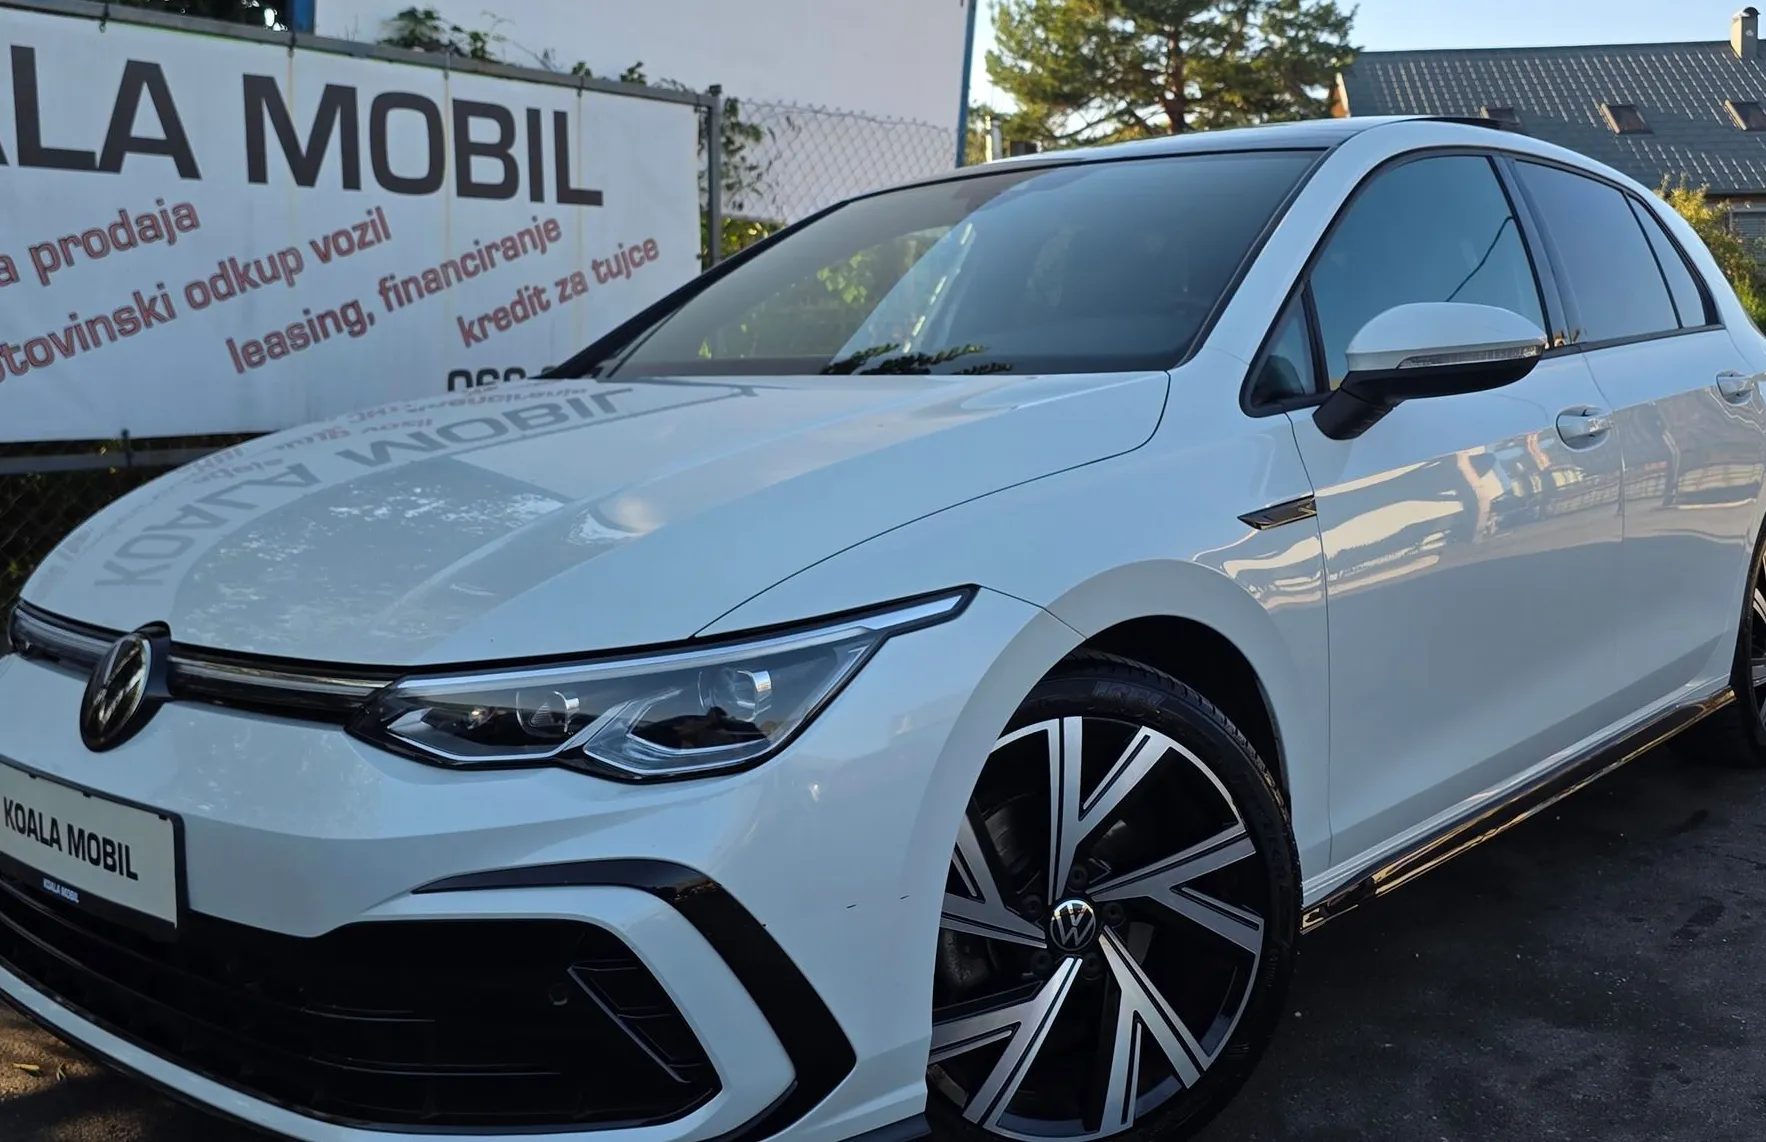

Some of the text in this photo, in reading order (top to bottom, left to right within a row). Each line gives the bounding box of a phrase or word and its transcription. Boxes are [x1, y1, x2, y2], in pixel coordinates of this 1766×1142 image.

[0, 45, 603, 206] LA MOBIL
[0, 205, 392, 383] tovinski odkup vozil
[29, 198, 200, 287] prodaja
[225, 215, 562, 374] leasing, financiranje
[457, 237, 660, 348] kredit za tujce
[4, 796, 139, 881] KOALA MOBIL
